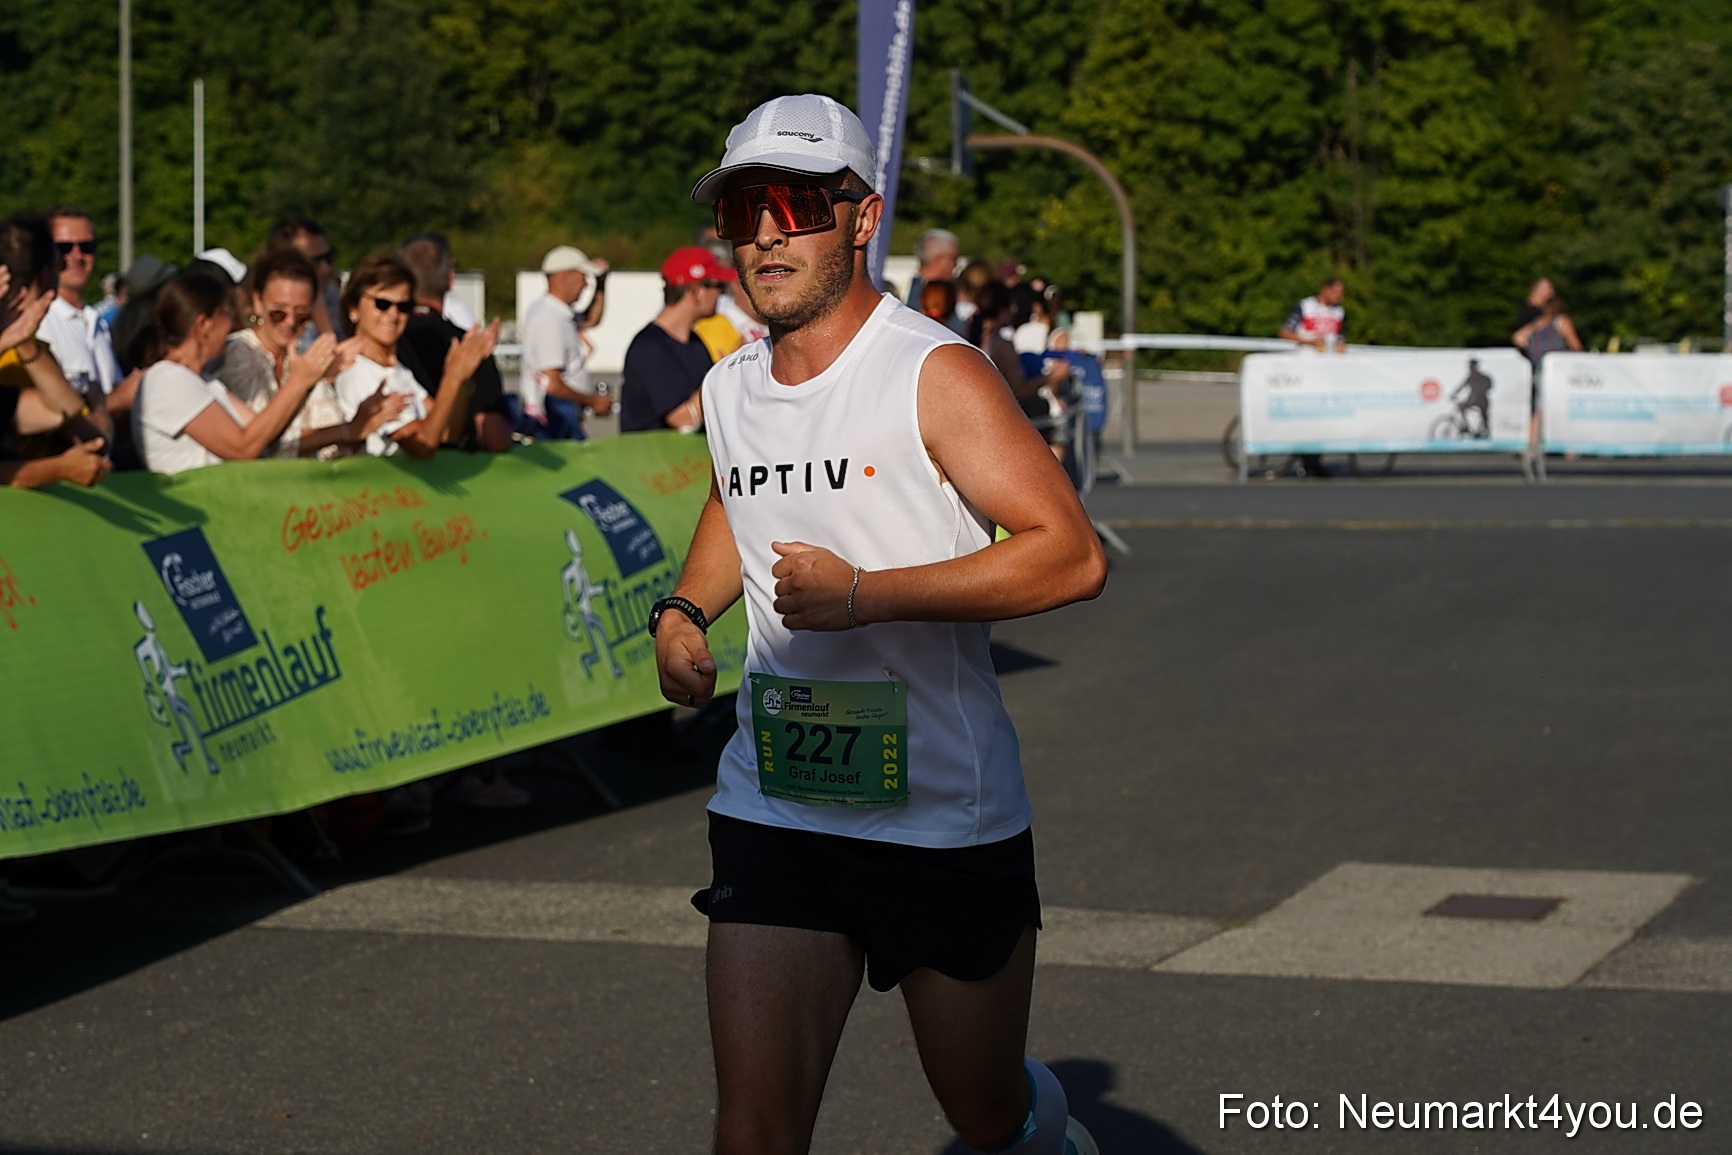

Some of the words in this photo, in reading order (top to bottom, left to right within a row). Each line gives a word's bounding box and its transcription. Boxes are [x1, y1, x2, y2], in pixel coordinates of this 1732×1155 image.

[777, 130, 815, 139] saucony
[729, 458, 849, 497] APTIV
[184, 605, 341, 735] firmenlauf
[784, 702, 830, 712] Firmenlauf
[761, 731, 774, 773] RUN
[785, 721, 862, 766] 227
[882, 733, 898, 789] 2022
[789, 766, 816, 780] Graf
[820, 770, 861, 784] Josef
